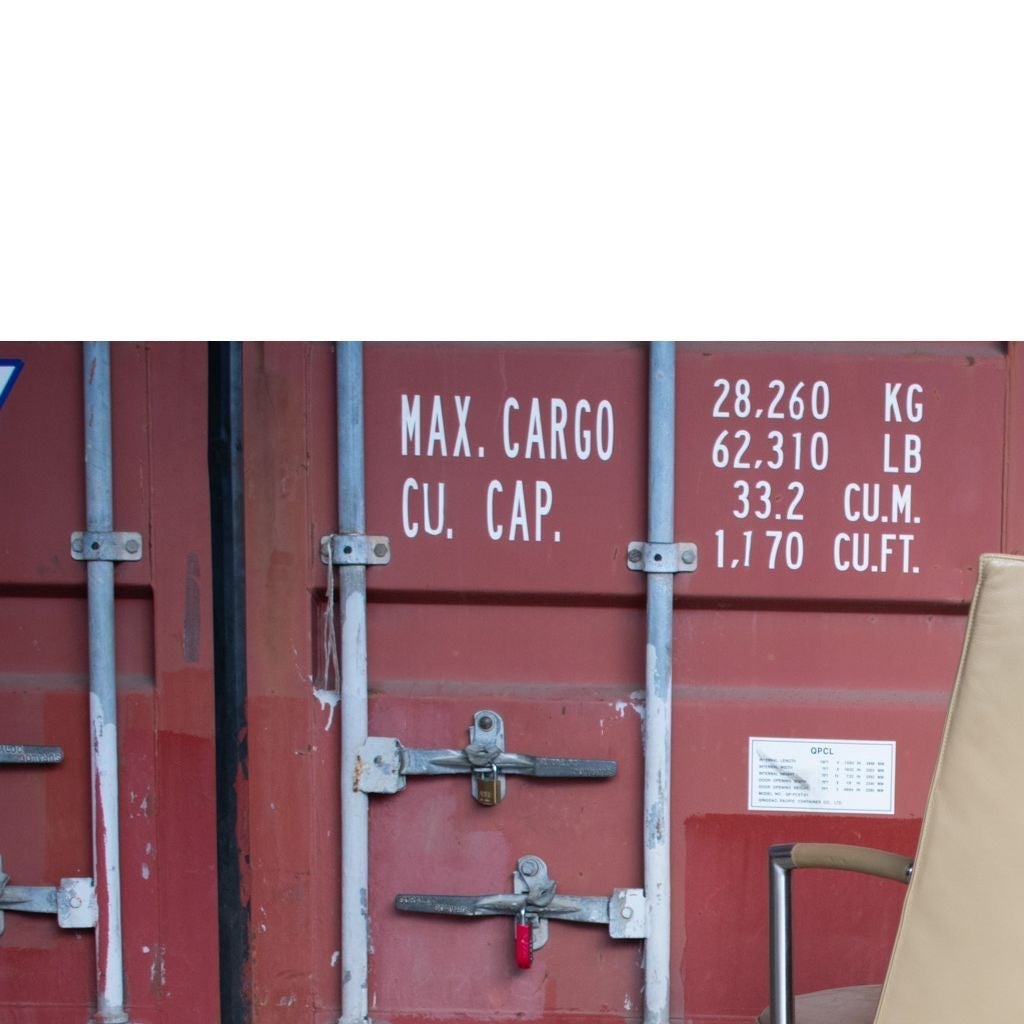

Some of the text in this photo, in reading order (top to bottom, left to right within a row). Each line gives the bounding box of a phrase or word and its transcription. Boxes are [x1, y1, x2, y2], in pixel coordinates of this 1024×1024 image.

[712, 378, 830, 421] 28,260
[884, 382, 924, 423] KG
[401, 394, 614, 462] MAX. CARGO
[711, 429, 829, 471] 62,310
[883, 433, 922, 474] LB
[401, 477, 561, 543] CU. CAP.
[732, 479, 805, 521] 33.2
[843, 482, 921, 524] CU.M.
[833, 531, 920, 574] CU.FT.
[810, 746, 835, 755] QPCL
